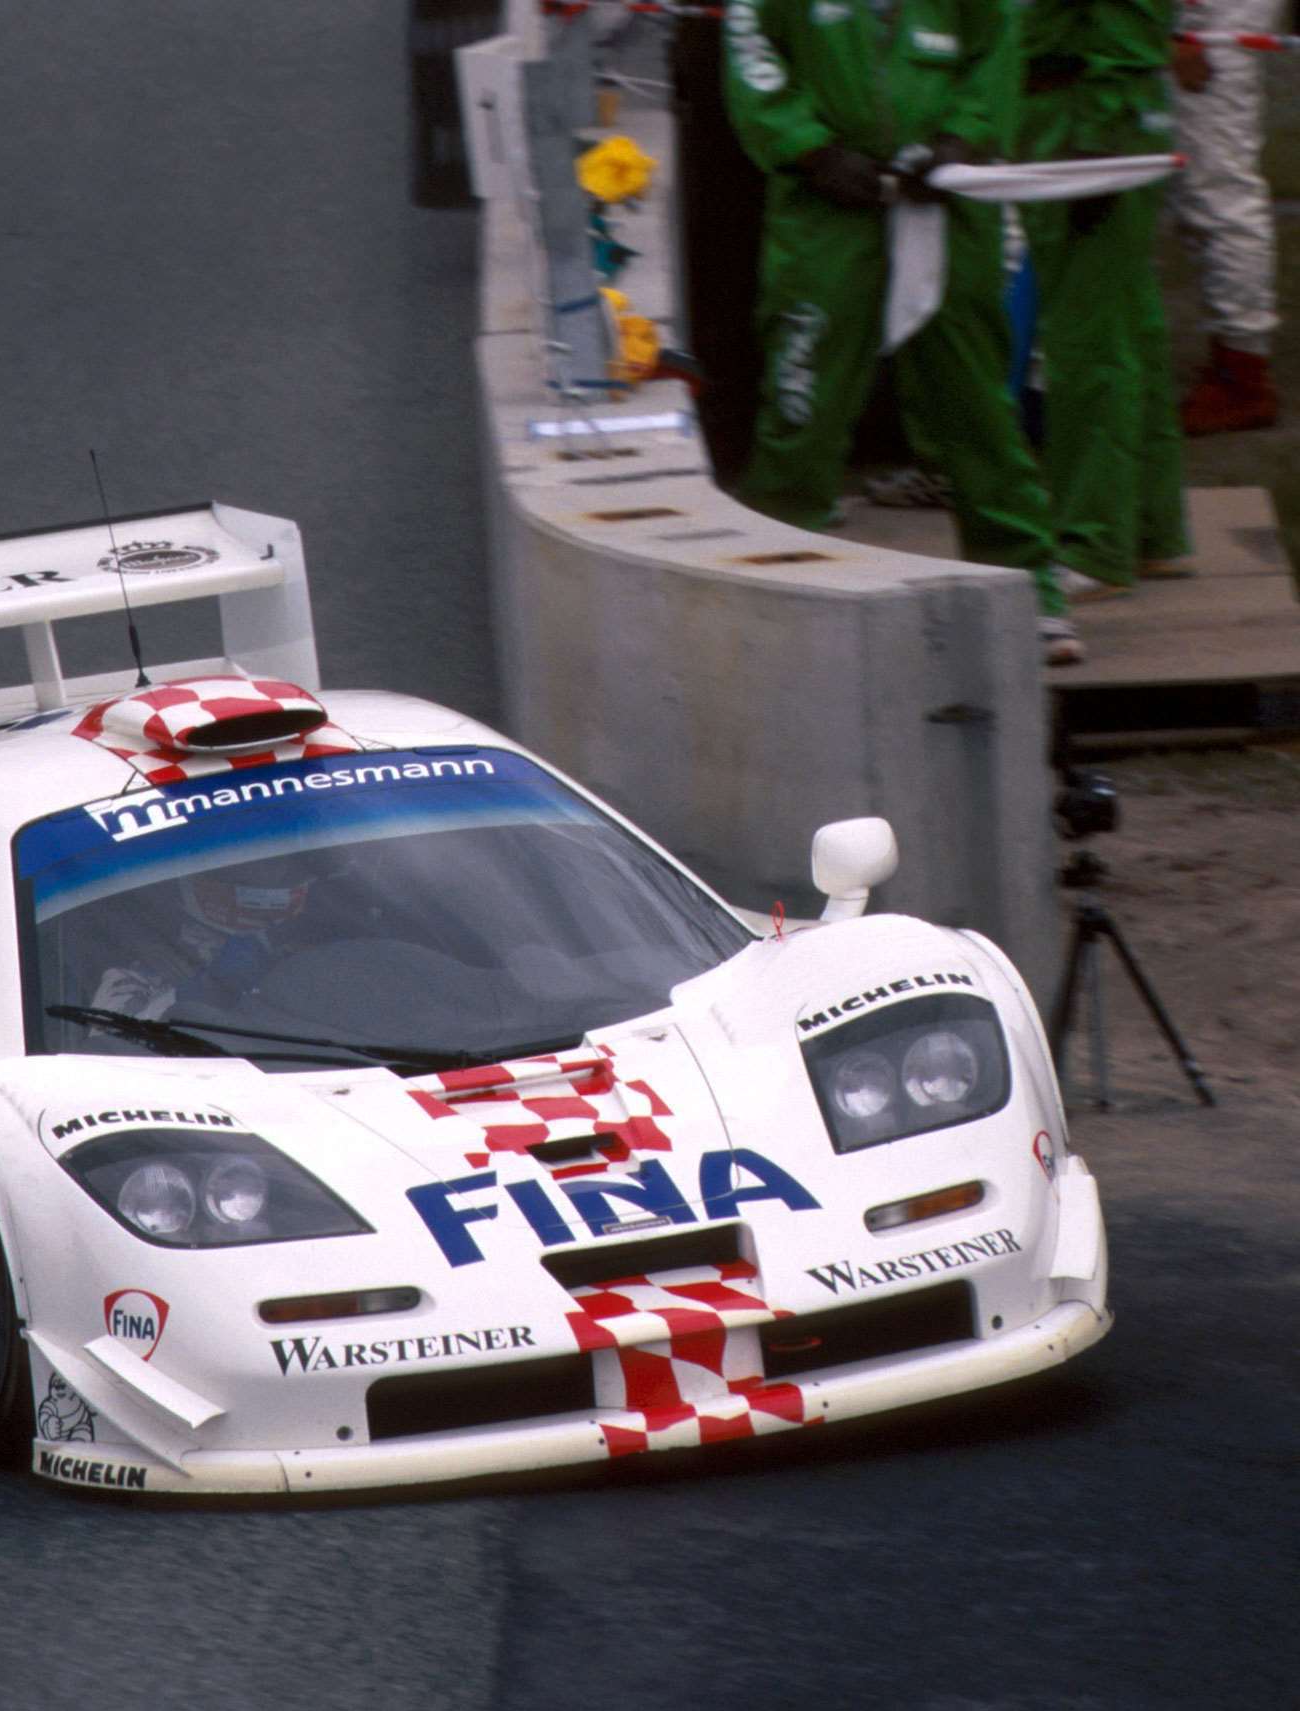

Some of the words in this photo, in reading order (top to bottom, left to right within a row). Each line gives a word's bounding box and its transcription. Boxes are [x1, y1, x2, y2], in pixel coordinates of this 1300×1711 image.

[166, 758, 495, 818] mannesmann
[797, 973, 973, 1032] MICHELIN
[52, 1110, 234, 1139] MICHELIN
[406, 1148, 823, 1268] FINA
[805, 1229, 1022, 1295] WARSTEINER
[113, 1310, 155, 1340] FINA
[269, 1325, 536, 1377] WARSTEINER
[40, 1451, 147, 1488] MICHELIN
